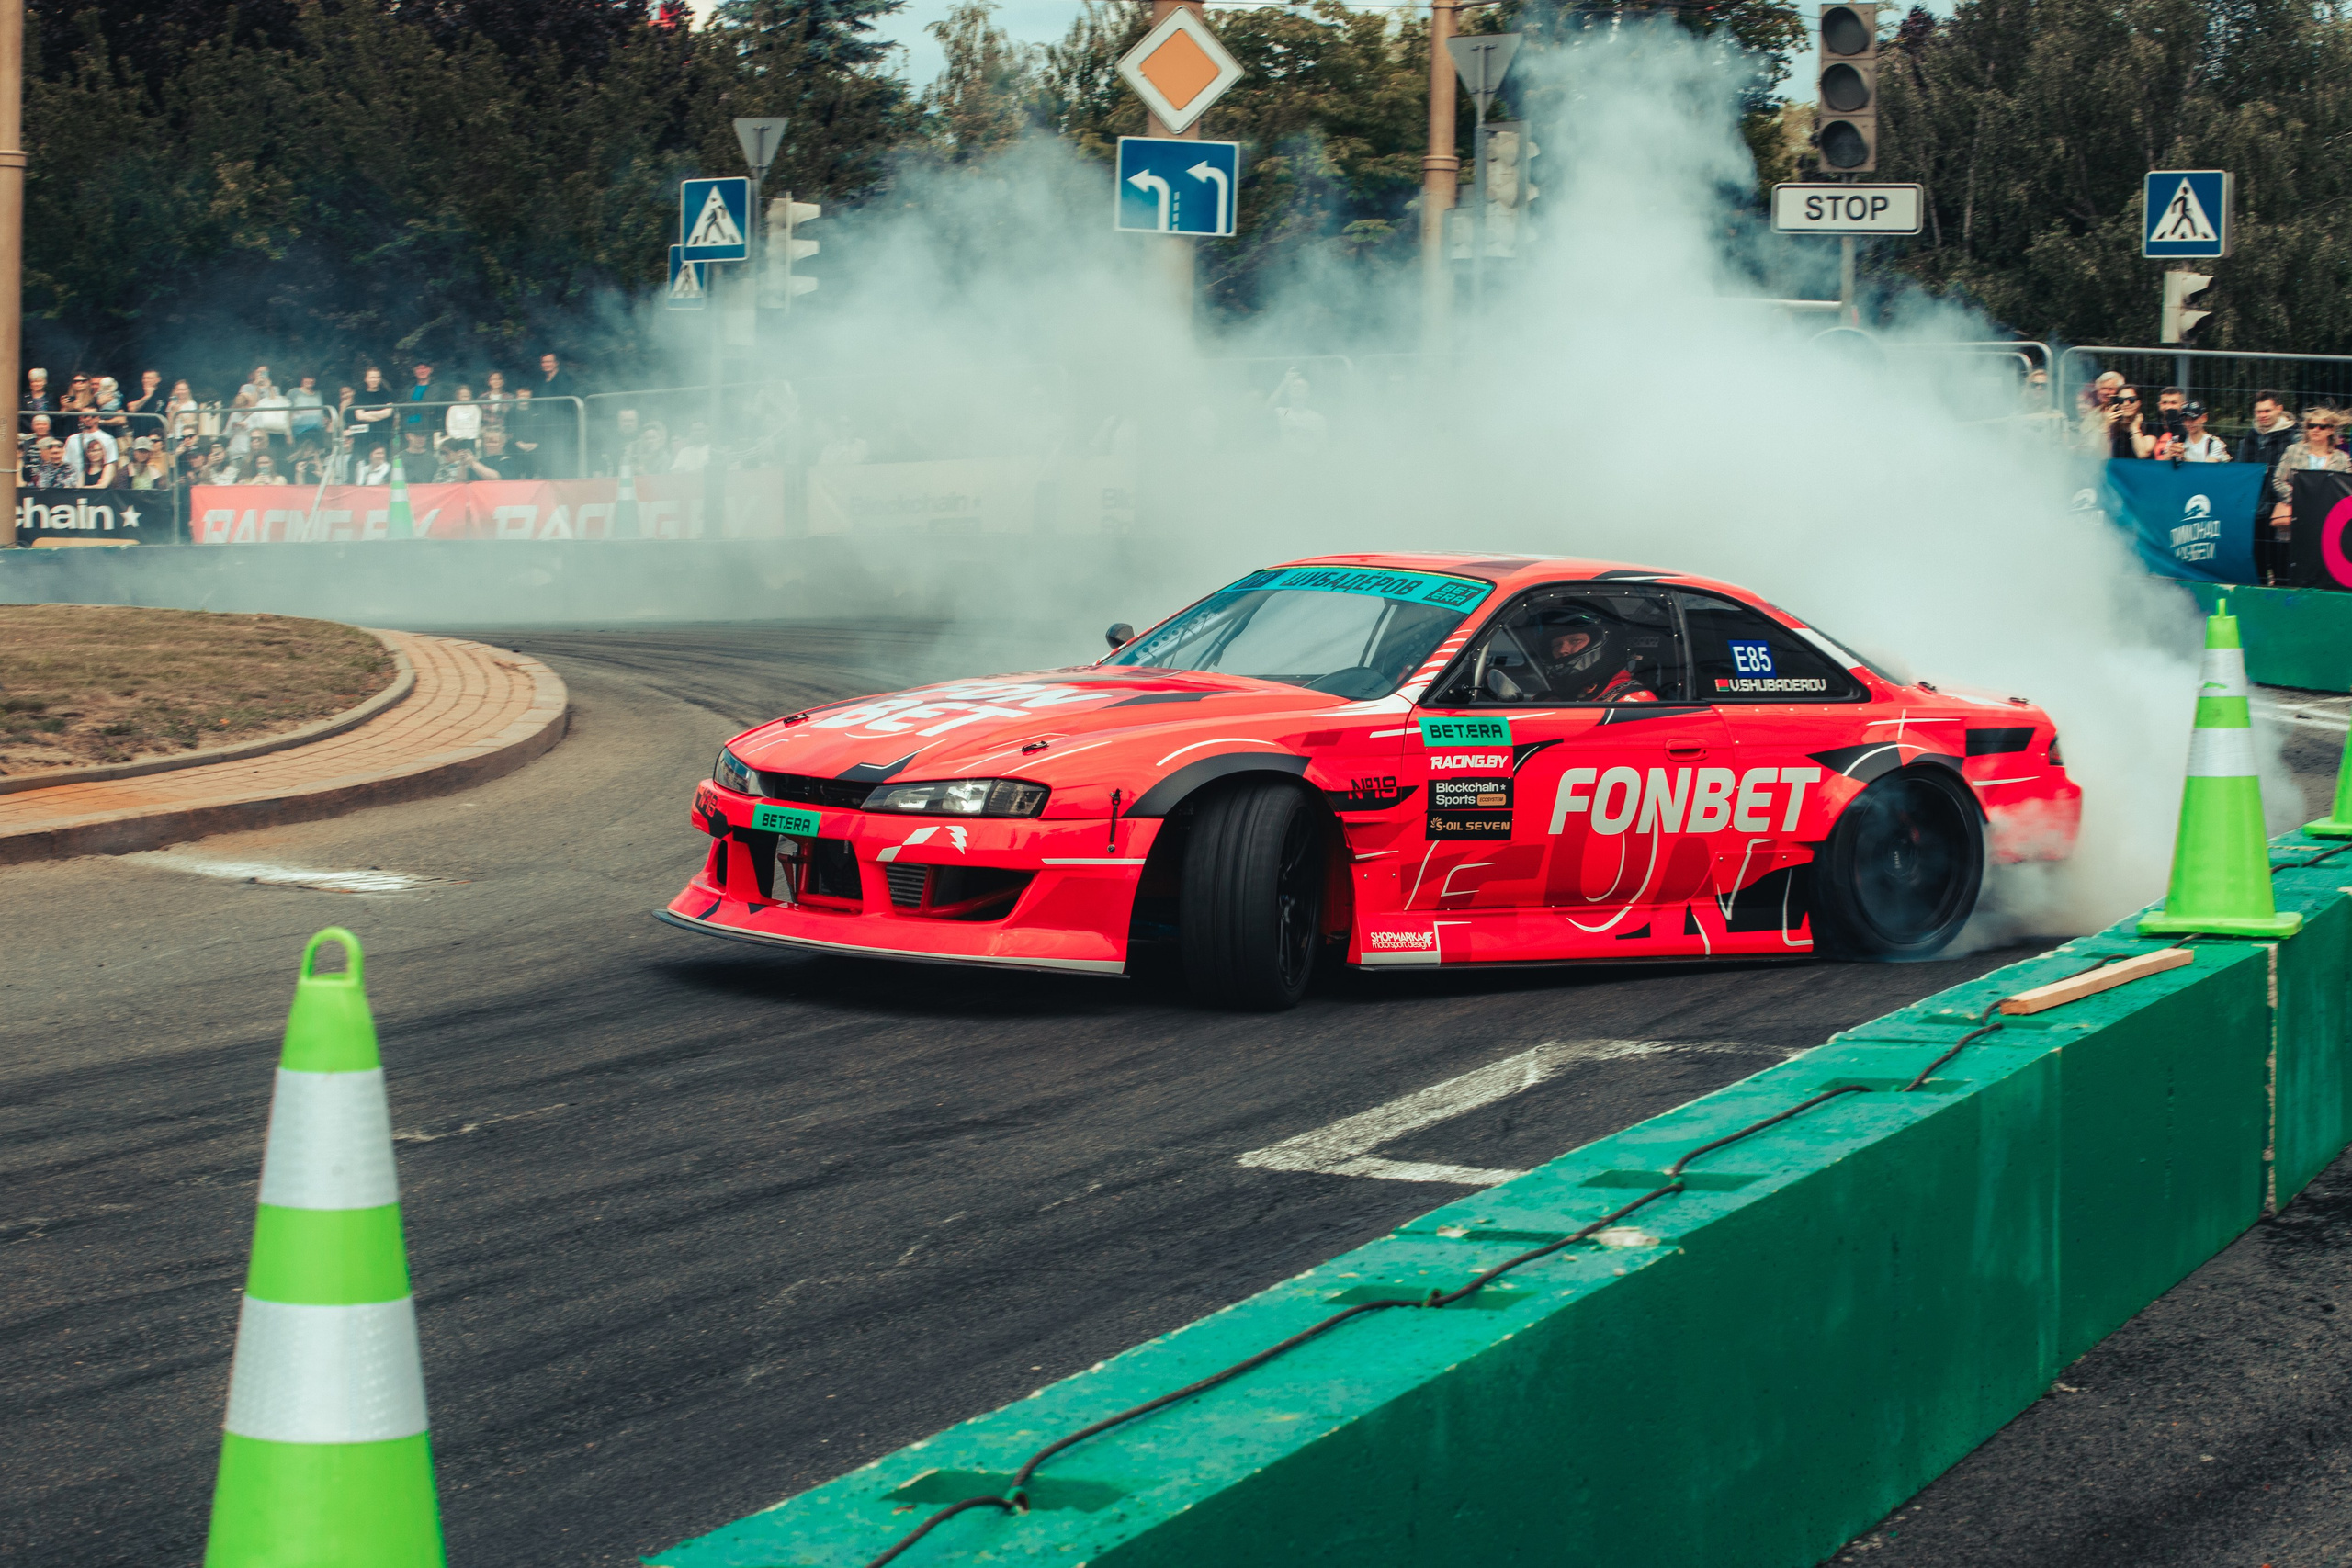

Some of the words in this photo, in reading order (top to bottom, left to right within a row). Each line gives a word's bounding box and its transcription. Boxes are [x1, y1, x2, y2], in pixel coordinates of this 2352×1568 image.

[1804, 195, 1890, 221] STOP
[1280, 570, 1424, 596] ШУБАДЁРОВ
[1440, 584, 1479, 596] BET
[1732, 646, 1772, 672] E85
[810, 699, 1033, 737] BET
[1430, 754, 1509, 770] RACING.BY
[1435, 781, 1499, 794] Blockchain
[1435, 794, 1476, 807] Sports
[1547, 766, 1822, 836] FONBET
[1465, 820, 1510, 831] SEVEN
[1370, 931, 1425, 942] SHOPMARKA
[1372, 941, 1408, 950] motorsport
